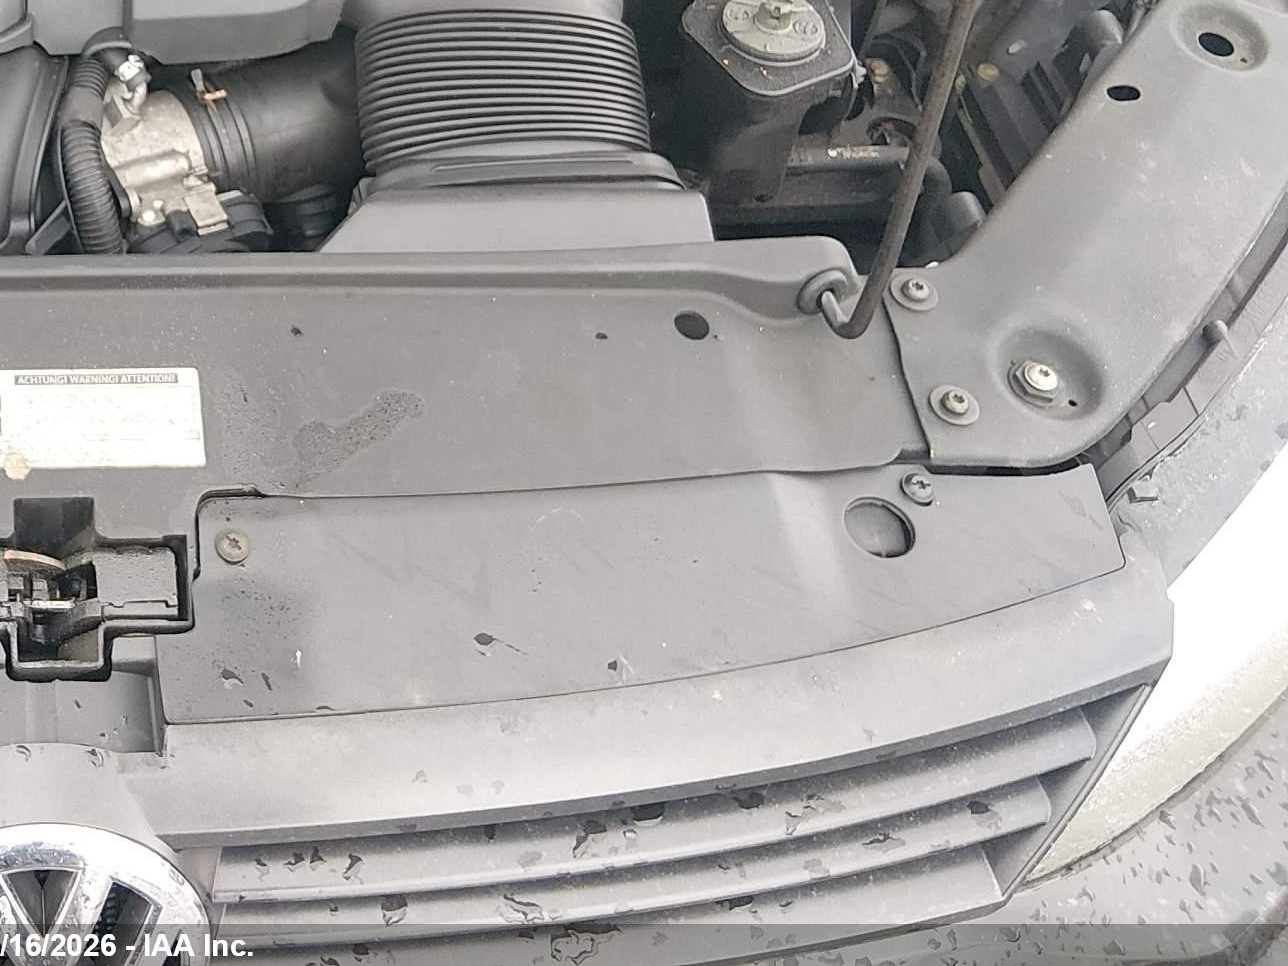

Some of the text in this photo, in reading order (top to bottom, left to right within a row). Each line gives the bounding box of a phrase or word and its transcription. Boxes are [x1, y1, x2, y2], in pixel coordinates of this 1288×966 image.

[17, 373, 176, 385] ACHTUNG! WARNING! ATTENTION!
